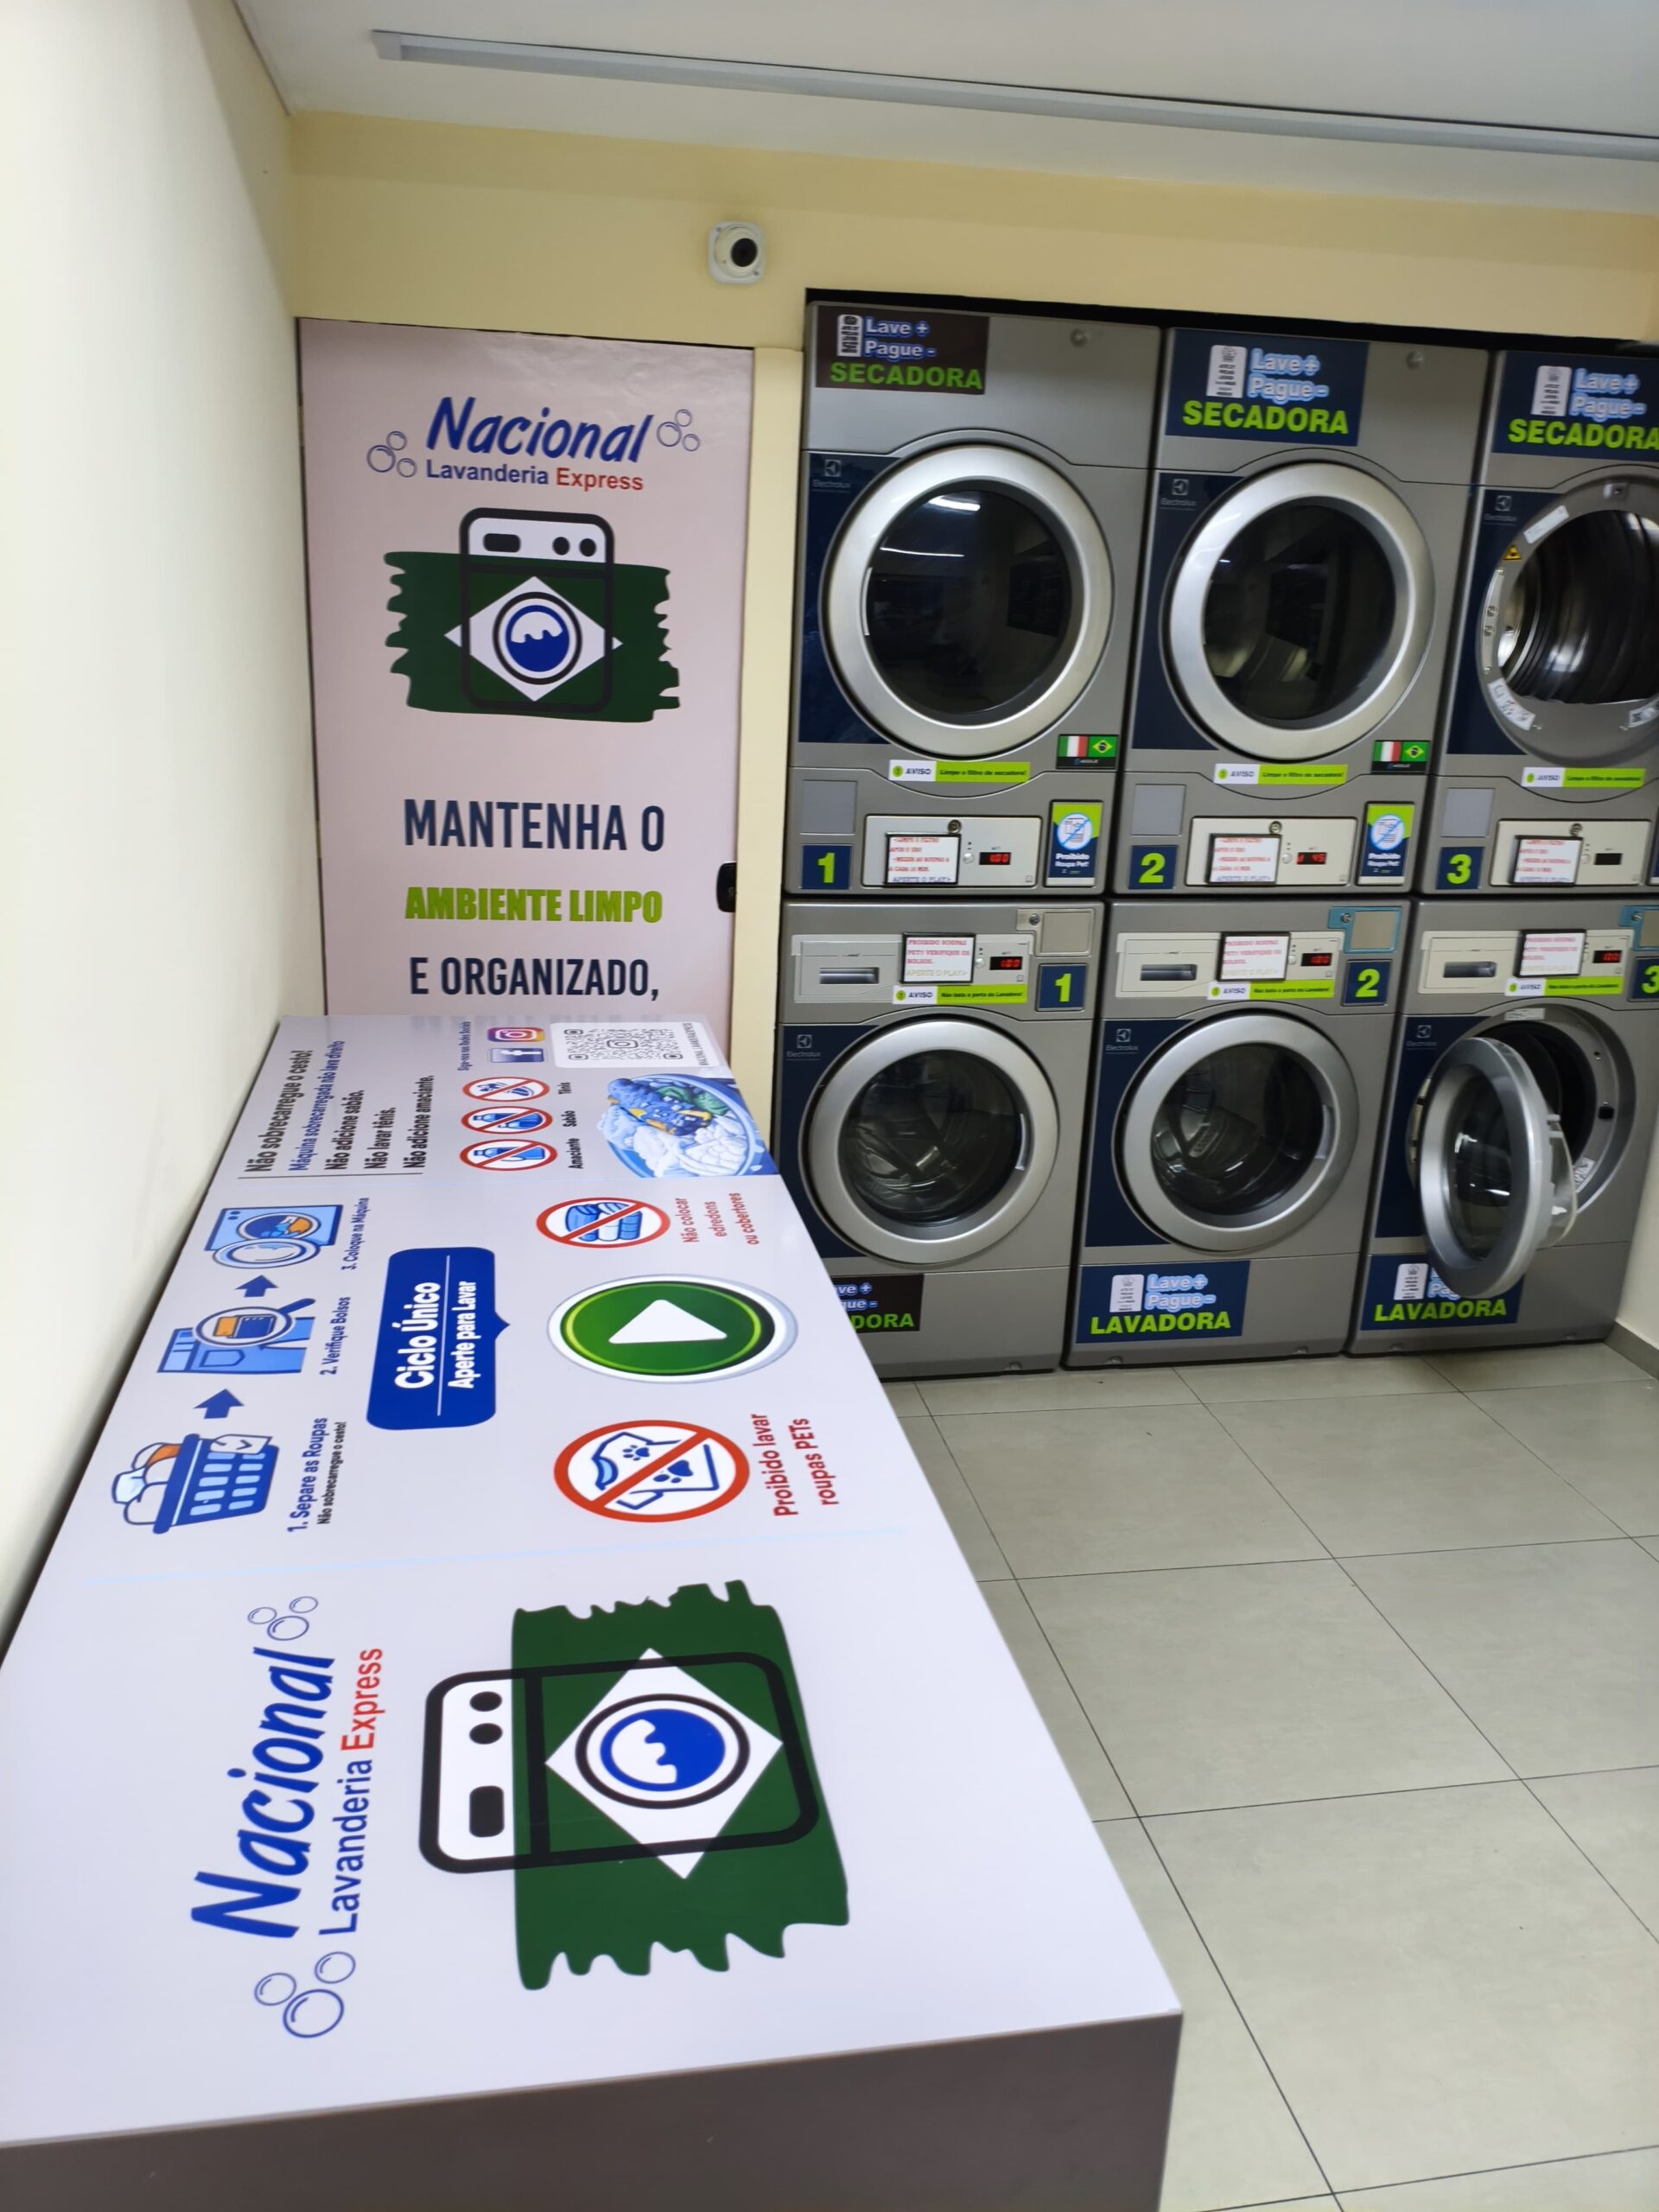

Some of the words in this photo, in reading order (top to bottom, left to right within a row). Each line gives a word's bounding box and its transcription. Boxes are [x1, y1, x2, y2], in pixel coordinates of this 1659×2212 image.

[866, 318, 912, 334] Lave
[865, 340, 923, 359] Pague
[1252, 350, 1302, 372] Lave
[830, 362, 982, 389] SECADORA
[1250, 377, 1314, 400] Pague
[1575, 370, 1622, 390] Lave
[1183, 400, 1348, 434] SECADORA
[1572, 395, 1630, 417] Pague
[426, 397, 654, 462] Nacional
[1508, 418, 1659, 450] SECADORA
[426, 459, 549, 485] Lavanderia
[556, 467, 644, 492] Express
[404, 799, 626, 850] MANTENHA
[641, 805, 664, 851] O
[817, 853, 836, 883] 1
[1139, 853, 1166, 884] 2
[1446, 854, 1472, 884] 3
[404, 887, 562, 921] AMBIENTE
[569, 890, 663, 923] LIMPO
[410, 957, 429, 995] E
[441, 957, 658, 1001] ORGANIZADO,
[1055, 973, 1071, 1002] 1
[1355, 969, 1380, 998] 2
[1642, 965, 1659, 994] 3
[289, 1050, 313, 1074] cesto!
[324, 1040, 345, 1058] direito
[316, 1071, 336, 1083] não
[319, 1059, 340, 1071] lava
[340, 1090, 365, 1114] sabão.
[412, 1075, 435, 1113] amaciante.
[556, 1082, 572, 1095] Tênis
[257, 1082, 305, 1149] sobrecarregue
[302, 1084, 334, 1136] sobrecarregada
[372, 1107, 397, 1128] tênis.
[561, 1110, 577, 1128] Sabão
[331, 1115, 359, 1150] adicione
[366, 1130, 392, 1150] lavar
[406, 1115, 431, 1149] adicione
[244, 1151, 277, 1172] Não
[288, 1138, 318, 1171] Máquina
[324, 1152, 350, 1170] Não
[363, 1151, 389, 1169] Não
[403, 1150, 427, 1168] Não
[566, 1138, 584, 1169] Amaciante
[351, 1198, 372, 1223] Máquina
[675, 1198, 694, 1225] colocar
[704, 1201, 728, 1236] edredons
[728, 1192, 755, 1233] cobertores
[343, 1233, 365, 1262] Coloque
[681, 1227, 700, 1243] Não
[745, 1235, 760, 1244] ou
[451, 1281, 476, 1311] Lavar
[1149, 1276, 1190, 1290] Lave
[330, 1297, 351, 1324] Bolsos
[391, 1282, 441, 1332] Único
[1147, 1294, 1202, 1309] Pague
[1374, 1299, 1507, 1322] LAVADORA
[456, 1313, 482, 1340] para
[850, 1313, 914, 1329] DORA
[1091, 1312, 1230, 1334] LAVADORA
[321, 1325, 348, 1365] Verifique
[319, 1366, 338, 1376] 2.
[394, 1335, 437, 1389] Ciclo
[448, 1342, 481, 1389] Aperte
[302, 1418, 330, 1458] Roupas
[334, 1421, 347, 1444] cesto!
[751, 1414, 776, 1446] lavar
[788, 1418, 818, 1450] PETs
[304, 1460, 320, 1472] as
[321, 1452, 344, 1506] sobrecarregue
[804, 1453, 840, 1505] roupas
[289, 1476, 318, 1519] Separe
[759, 1450, 799, 1516] Proibido
[287, 1522, 308, 1532] 1.
[316, 1508, 333, 1524] Não
[340, 1648, 385, 1751] Express
[190, 1646, 335, 1938] Nacional
[319, 1758, 373, 1936] Lavanderia
